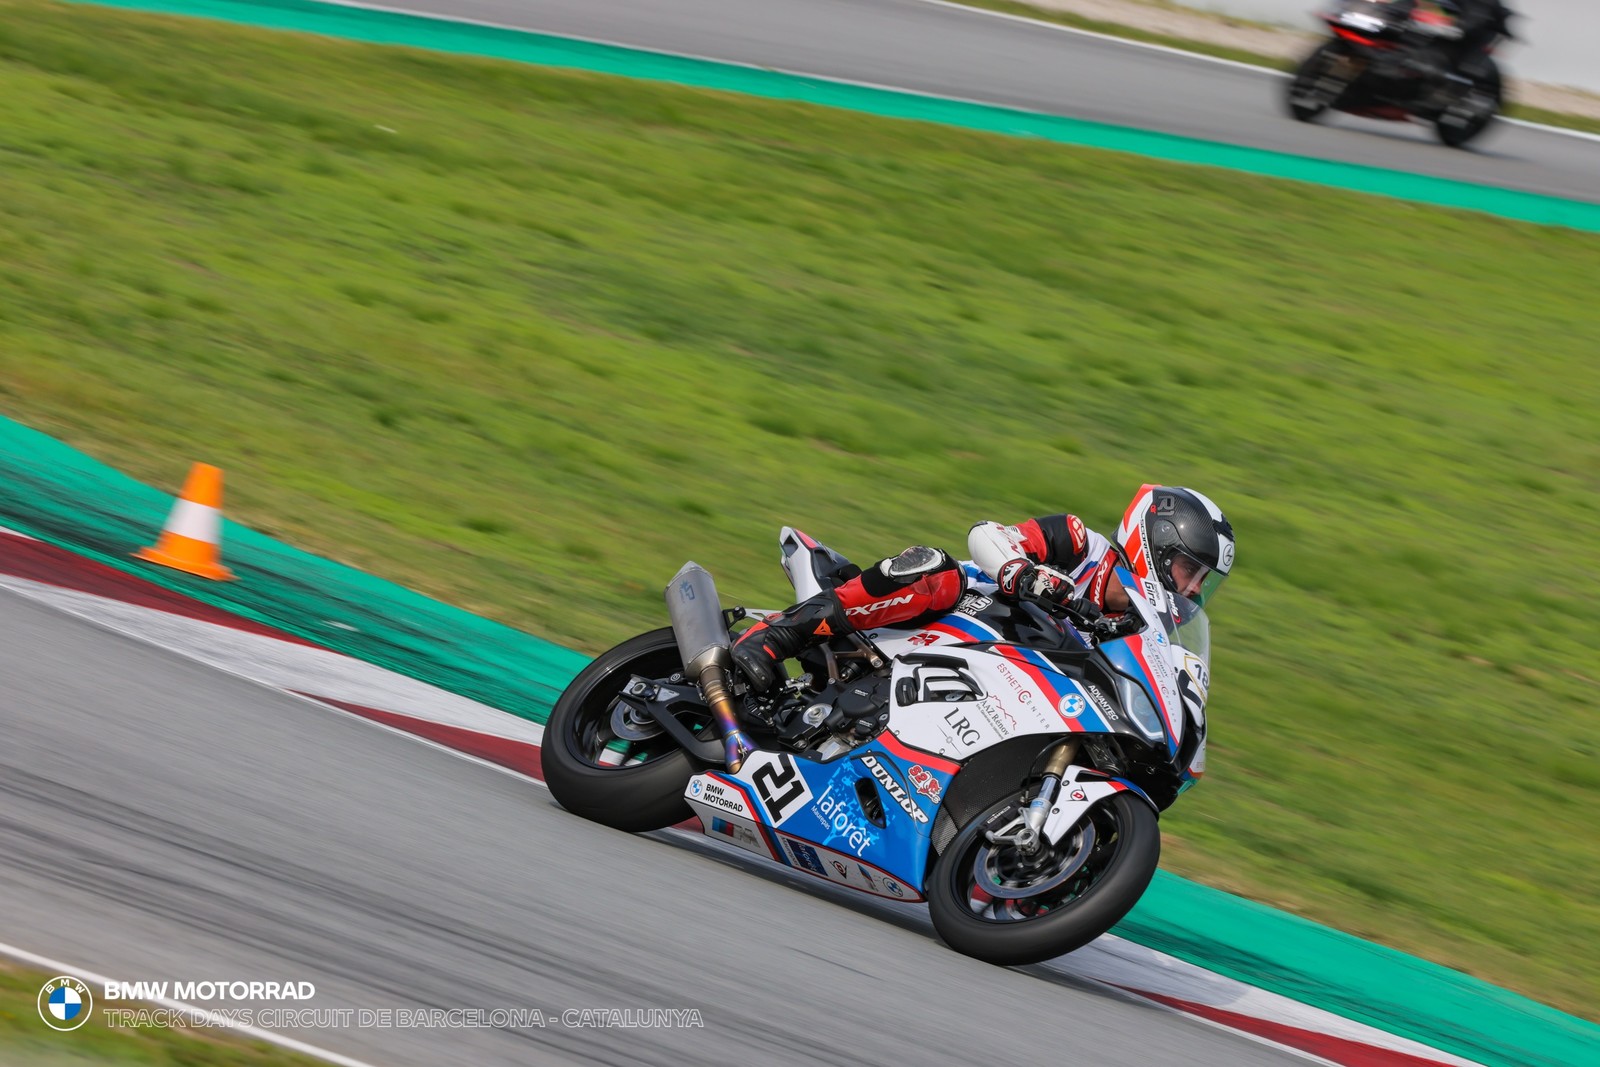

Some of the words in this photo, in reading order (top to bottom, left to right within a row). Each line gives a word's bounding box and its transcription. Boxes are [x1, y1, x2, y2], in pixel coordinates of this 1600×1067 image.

[1144, 581, 1157, 607] Gire
[980, 699, 995, 718] AAZ
[991, 712, 1010, 736] Rénov
[1088, 685, 1119, 721] ADVANTEC
[944, 707, 981, 746] LRG
[703, 793, 743, 812] MOTORRAD
[706, 784, 724, 796] BMW
[752, 752, 805, 824] 21
[860, 755, 929, 823] DUNLOP
[811, 805, 831, 830] Maurepas
[816, 785, 871, 857] laforêt
